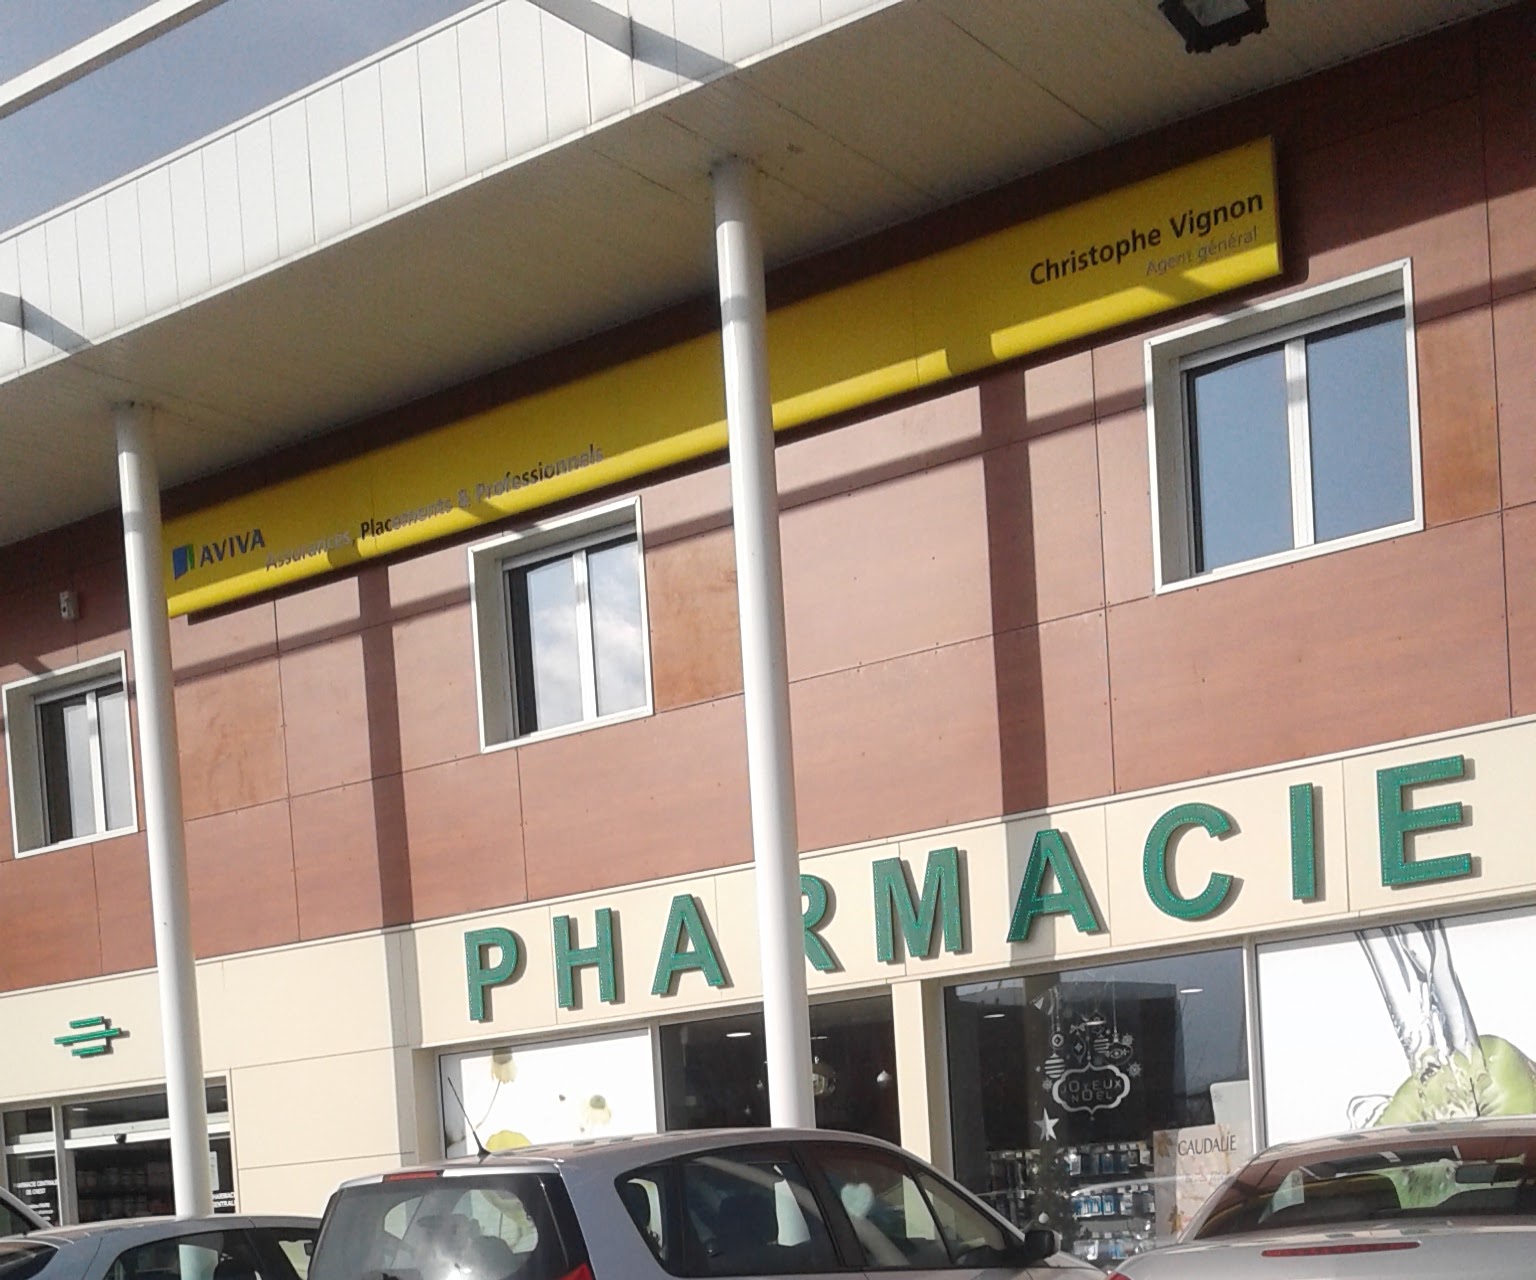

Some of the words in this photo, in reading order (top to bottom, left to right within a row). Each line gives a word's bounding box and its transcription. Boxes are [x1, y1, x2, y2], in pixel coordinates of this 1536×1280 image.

[1030, 228, 1161, 285] Christophe
[1169, 194, 1263, 239] Vignon
[1146, 251, 1193, 276] Agent
[1198, 225, 1258, 261] général
[360, 499, 453, 540] Placements
[476, 443, 604, 500] Professionnels
[200, 528, 265, 567] AVIVA
[464, 754, 1474, 1021] PHARMACIE
